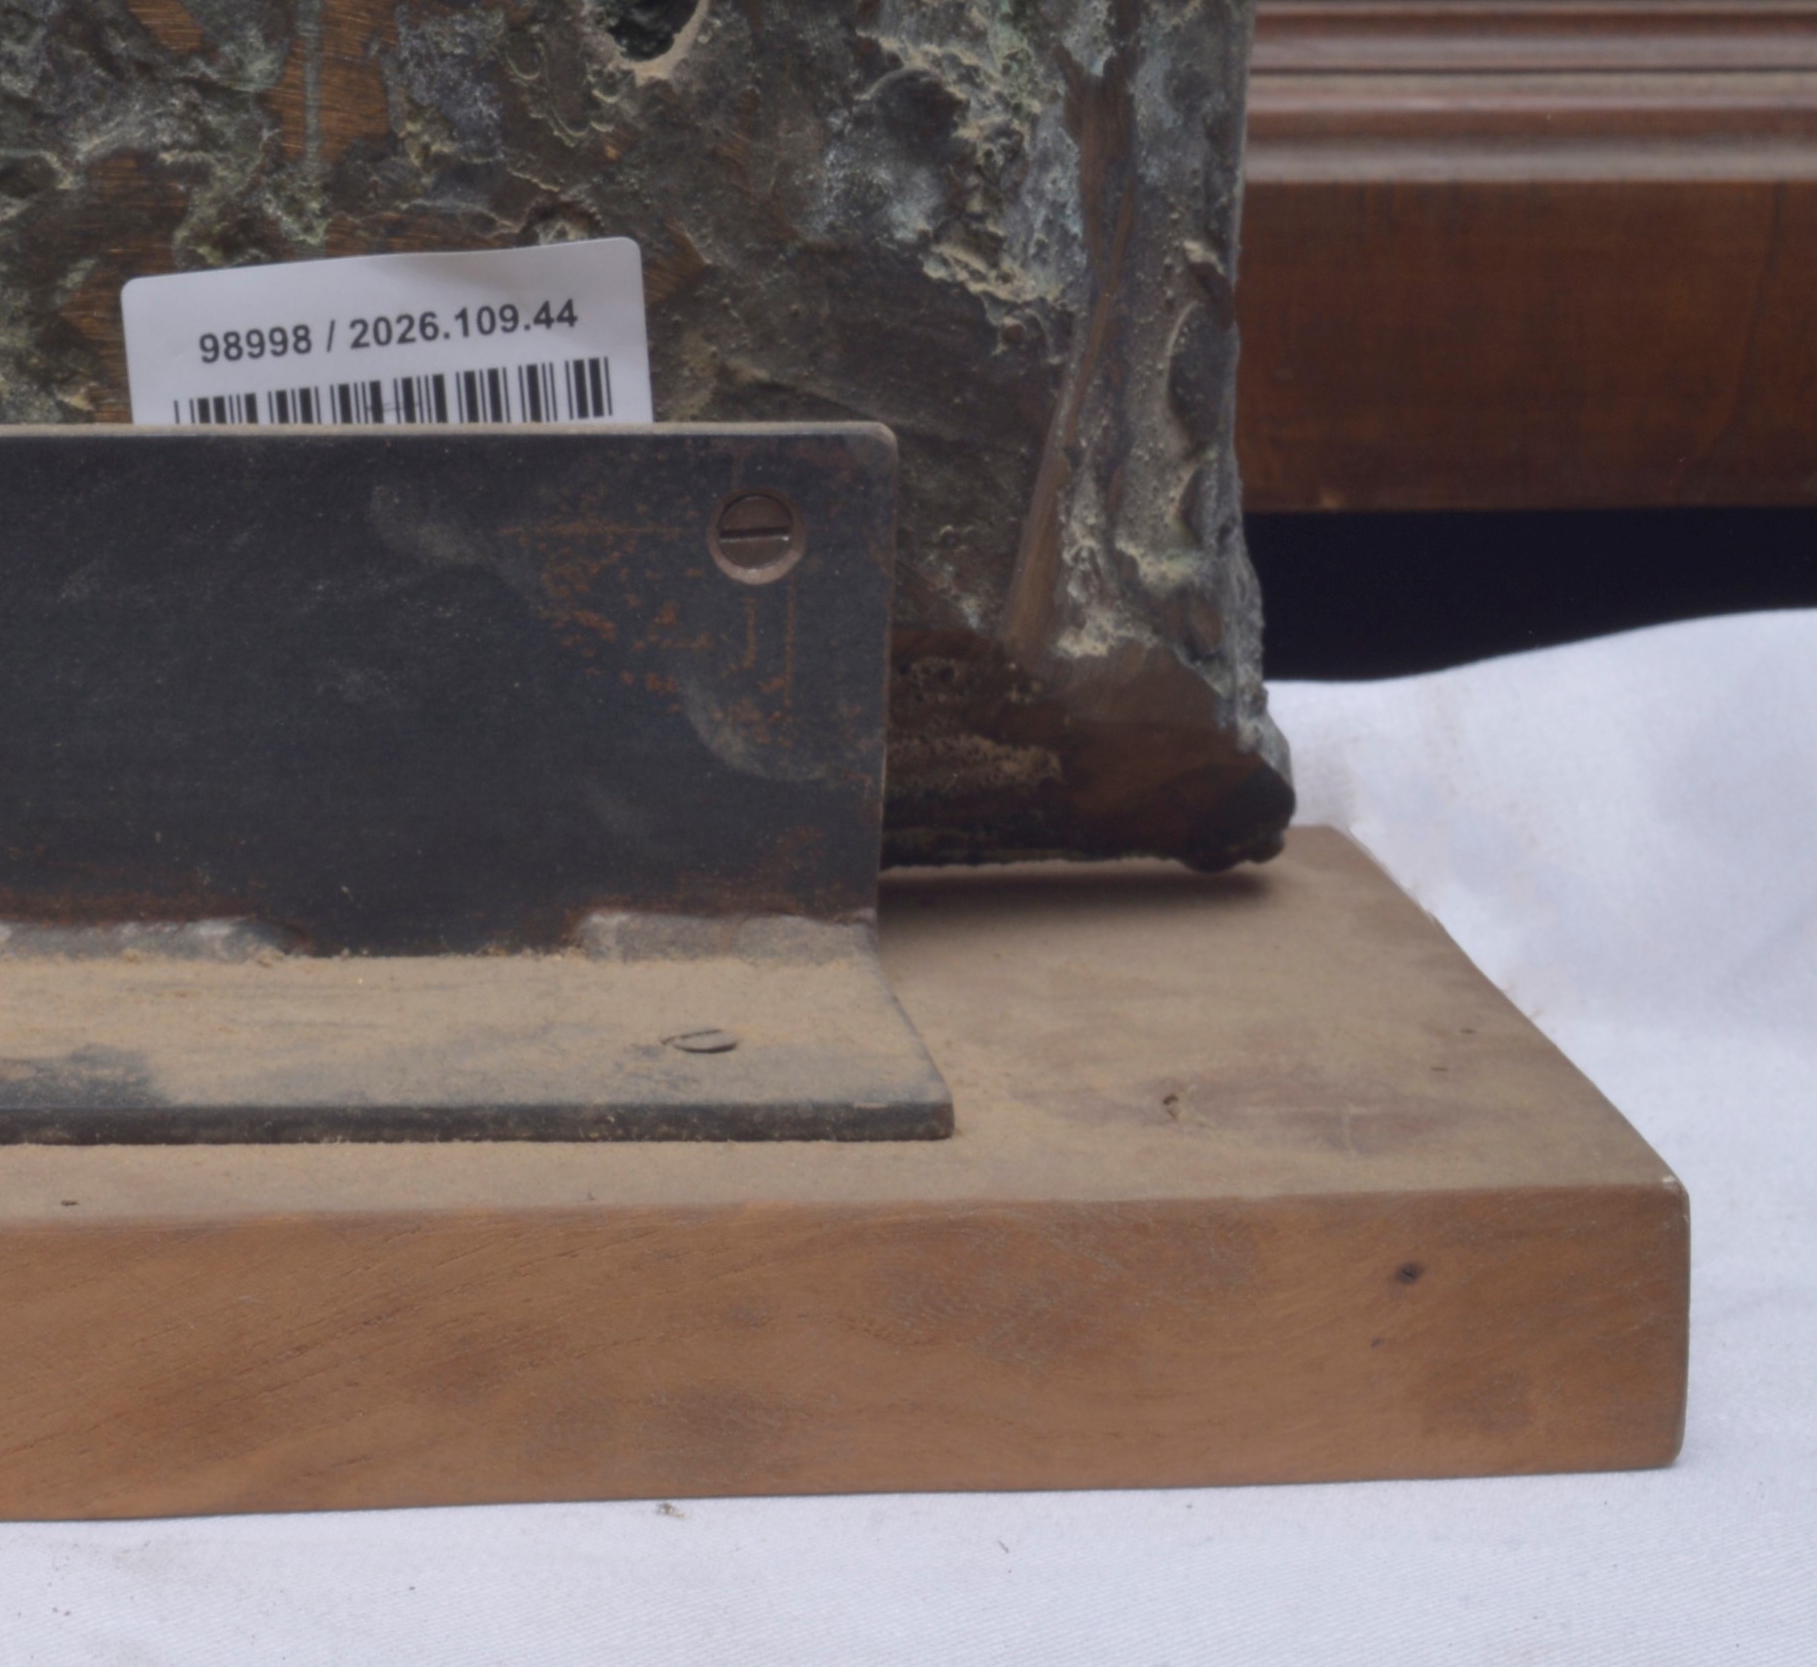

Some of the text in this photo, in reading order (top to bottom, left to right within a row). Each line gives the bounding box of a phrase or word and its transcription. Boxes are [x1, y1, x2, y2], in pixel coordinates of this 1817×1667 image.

[199, 299, 578, 363] 98998 / 2026.109.44
